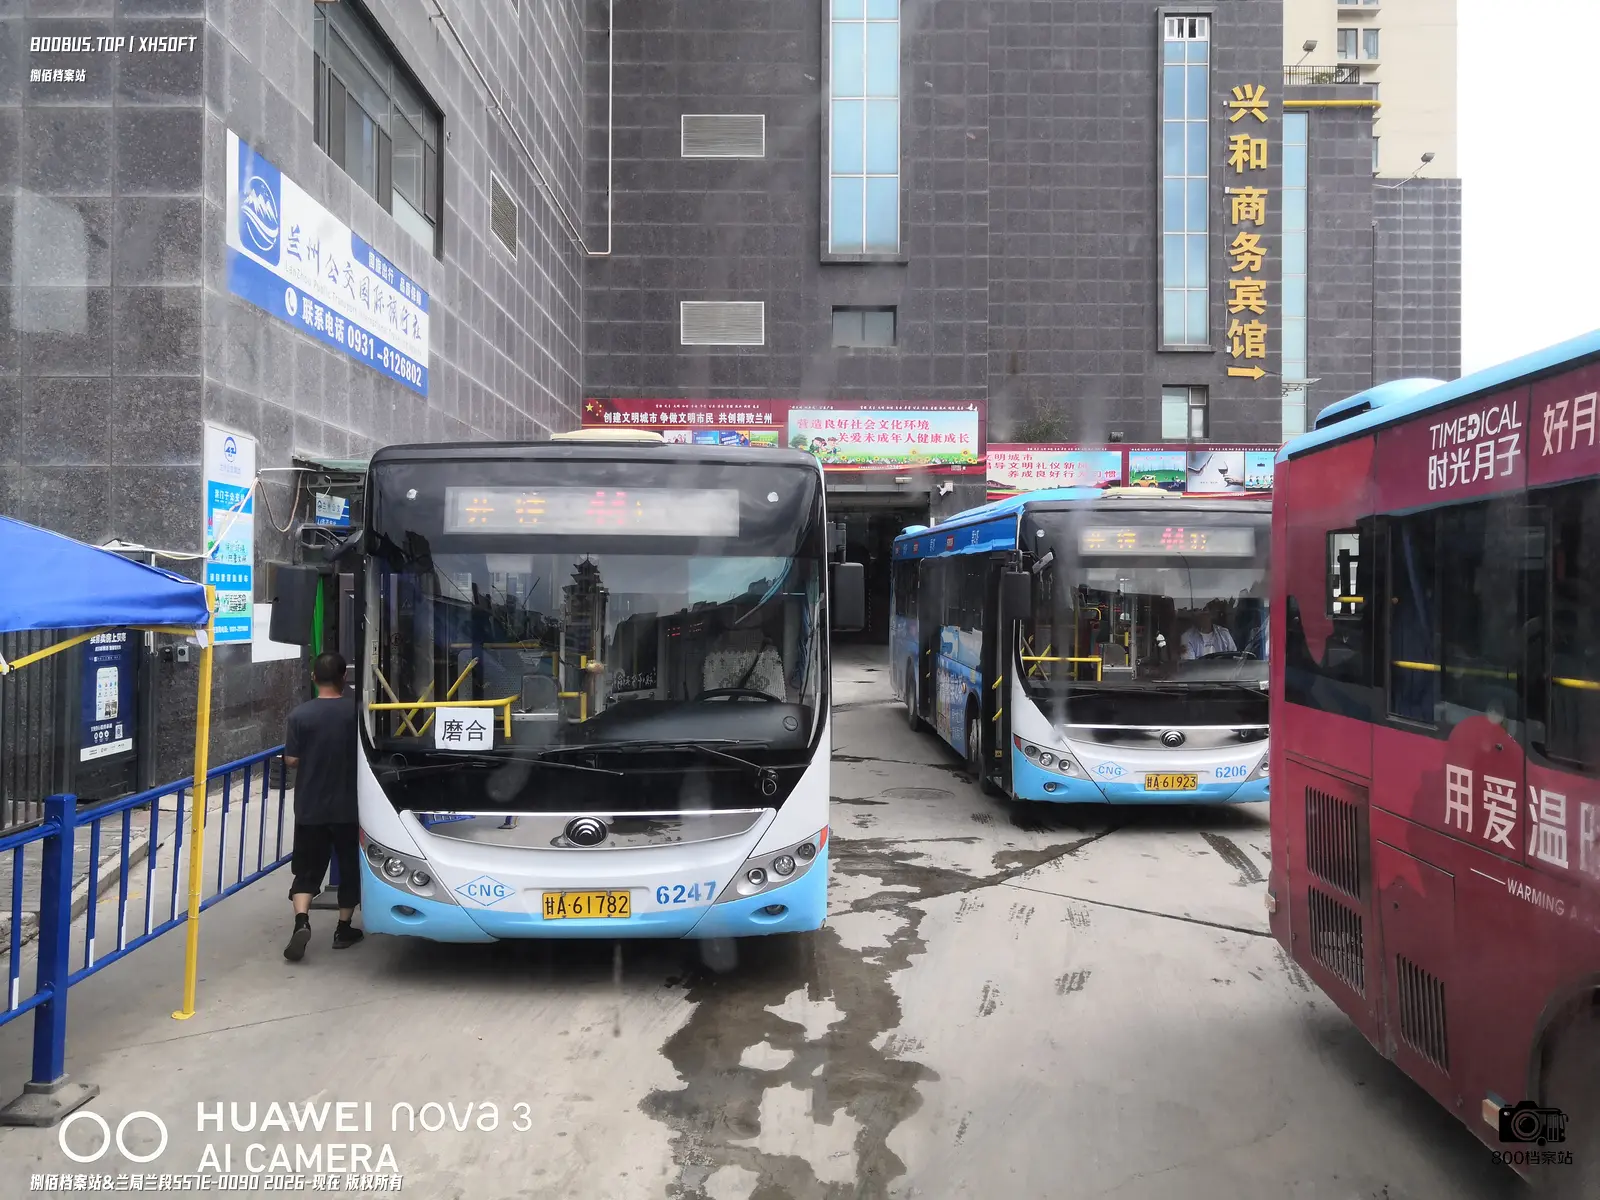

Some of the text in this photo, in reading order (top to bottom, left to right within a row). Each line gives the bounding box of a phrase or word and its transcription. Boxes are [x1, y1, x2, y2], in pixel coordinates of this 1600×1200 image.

[1227, 83, 1269, 359] 兴和商务宾馆
[286, 224, 422, 341] 兰州公交国际旅行社
[302, 296, 344, 344] 联系电话
[347, 325, 422, 387] 0931-8126802
[603, 412, 772, 424] 创建文明城市 争做文明市民 共创精致兰州
[797, 419, 930, 431] 营造良好社会文化环境
[1429, 400, 1522, 450] TIMEDICAL
[1541, 391, 1600, 457] 好月
[838, 432, 970, 444] 关爱未成年人健康成长
[1428, 433, 1521, 491] 时光月子
[441, 718, 488, 742] 磨合
[1097, 765, 1122, 776] CNG
[1215, 765, 1247, 778] 6206
[467, 884, 505, 899] CNG
[656, 880, 716, 905] 6247
[1507, 877, 1565, 916] WARMING
